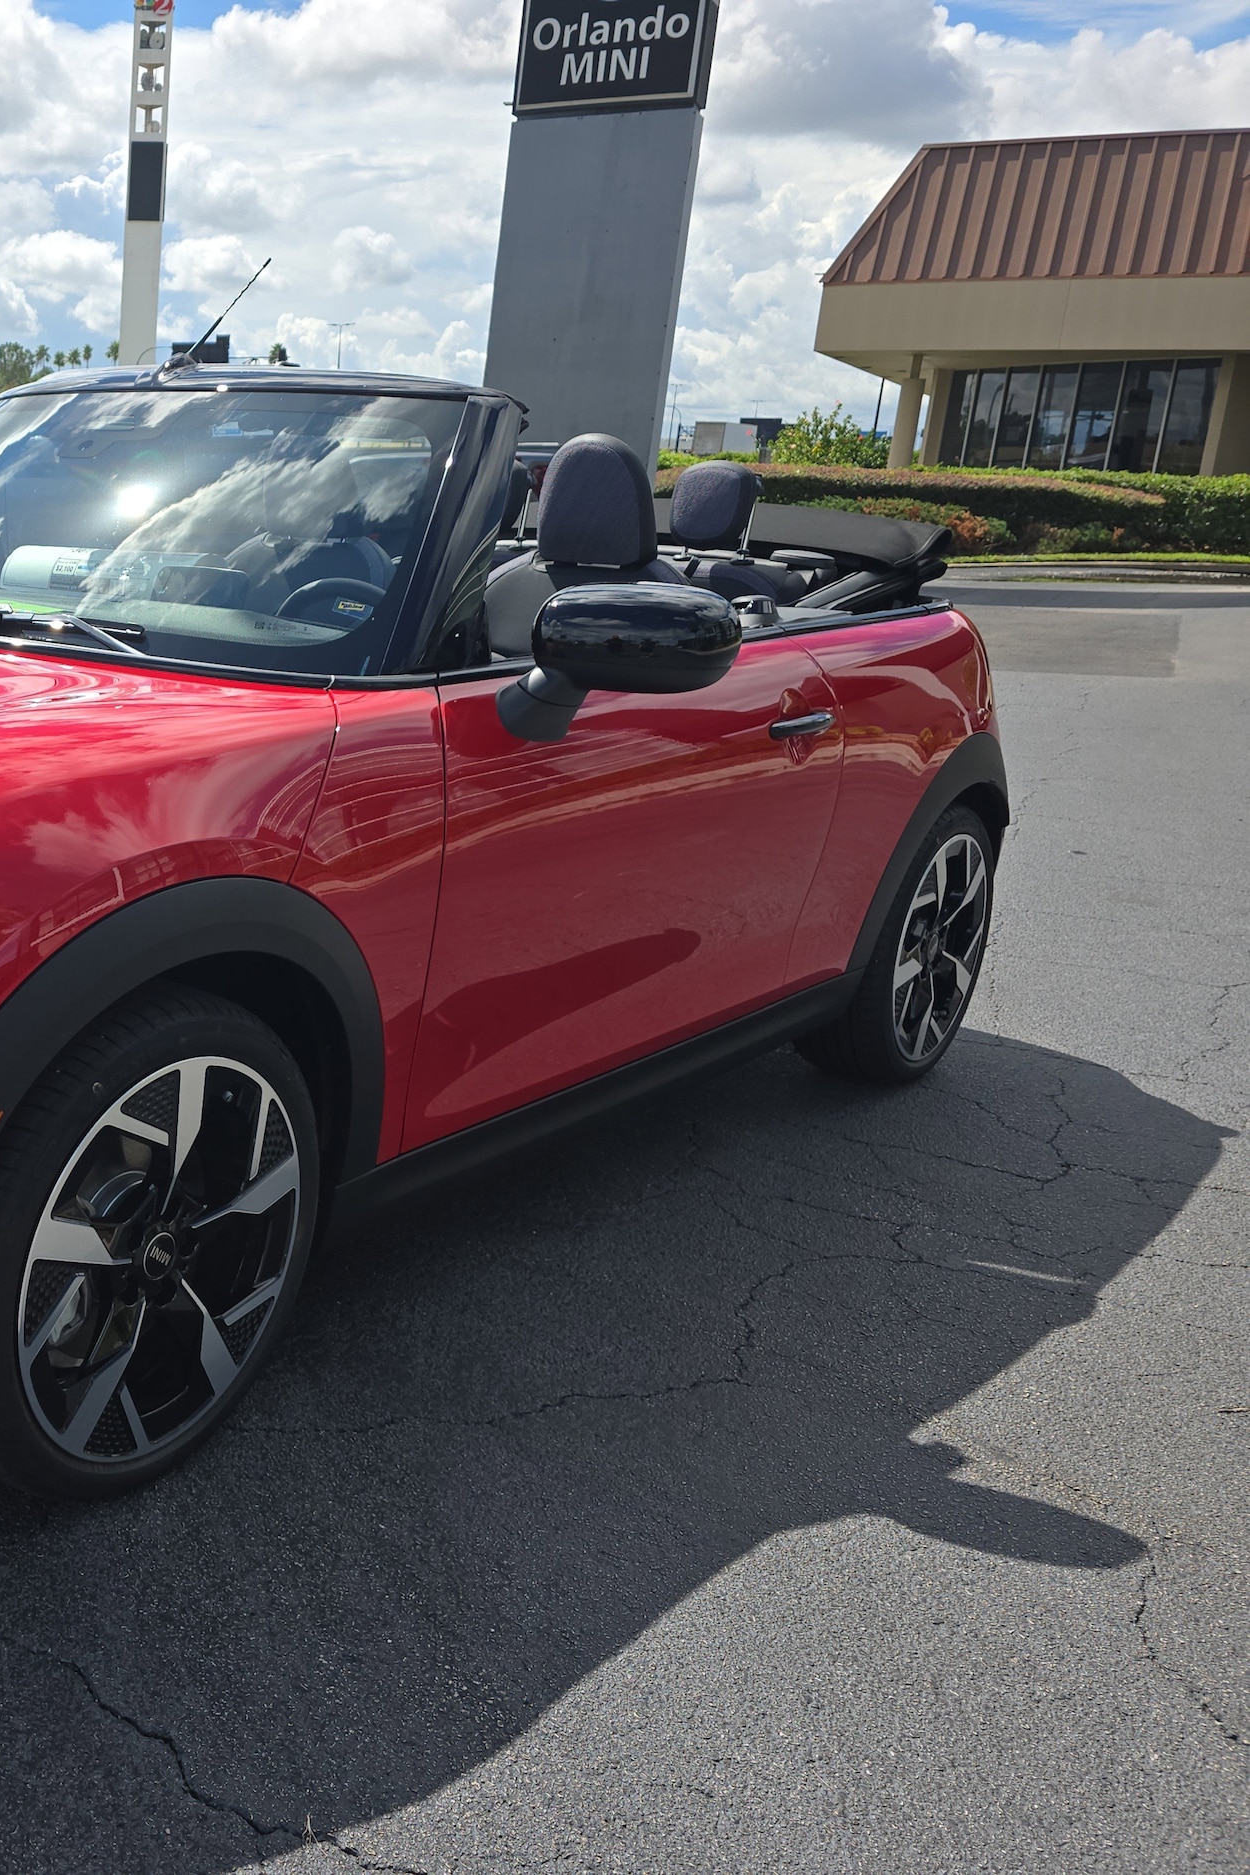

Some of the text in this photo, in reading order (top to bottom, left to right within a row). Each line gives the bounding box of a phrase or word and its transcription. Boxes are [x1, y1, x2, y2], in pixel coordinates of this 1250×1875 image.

[533, 5, 690, 51] Orlando
[560, 46, 650, 86] MINI
[150, 1245, 172, 1267] MINI
